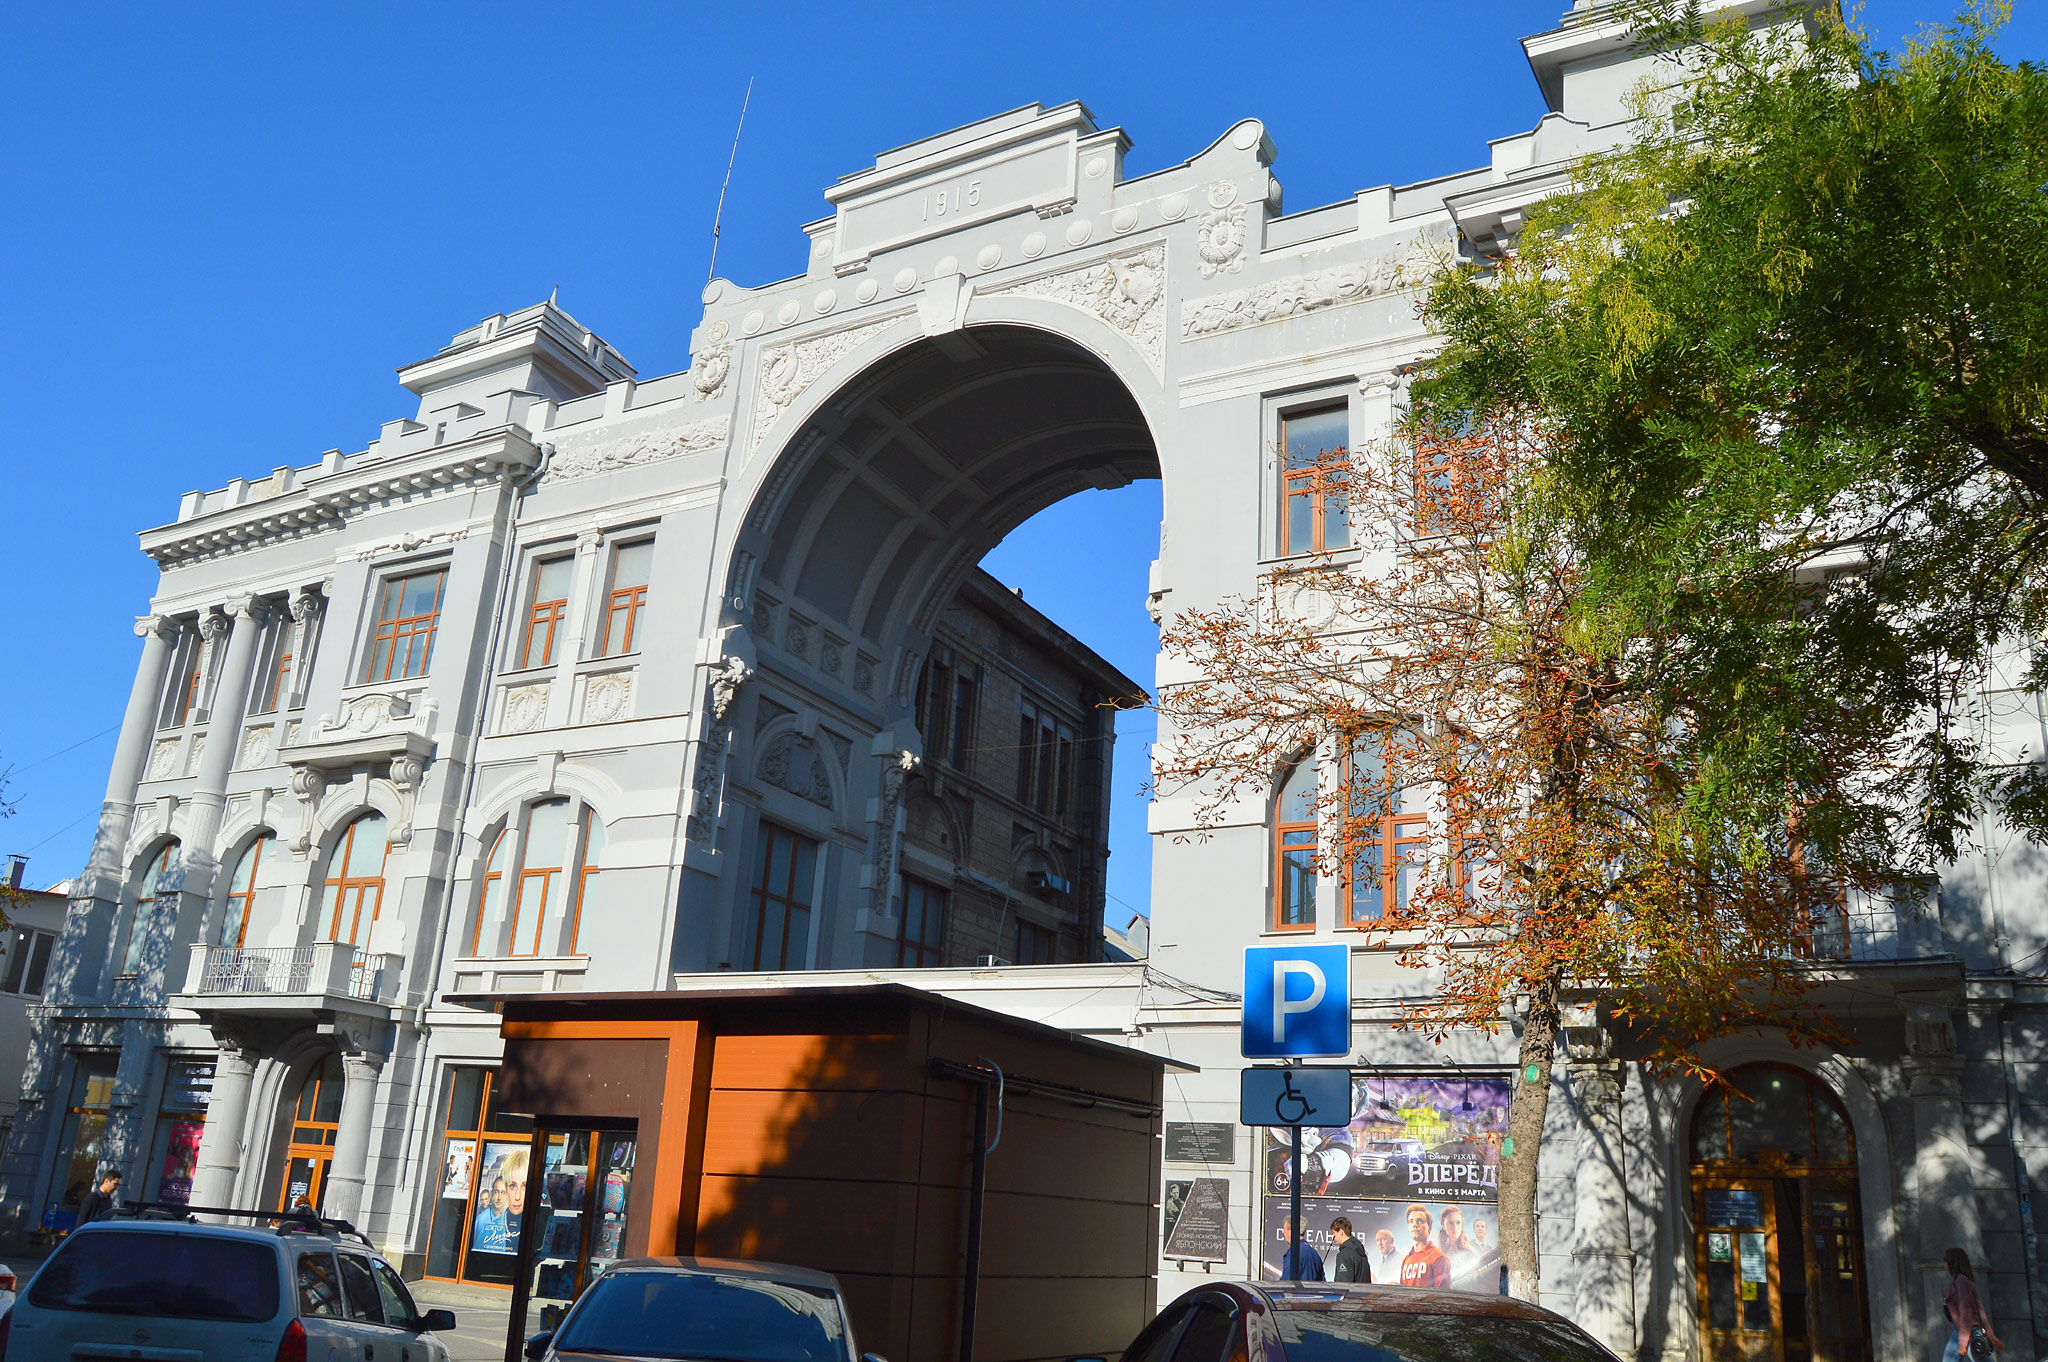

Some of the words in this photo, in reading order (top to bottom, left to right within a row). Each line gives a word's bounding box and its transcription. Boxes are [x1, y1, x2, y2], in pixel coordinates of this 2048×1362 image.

[922, 179, 982, 222] 1915
[1273, 960, 1327, 1043] P
[1426, 1151, 1450, 1162] Disney
[1276, 1176, 1289, 1186] 6+
[1407, 1161, 1498, 1190] ВПЕРЁД
[1176, 1240, 1222, 1250] ЯБЛОНСКИЙ
